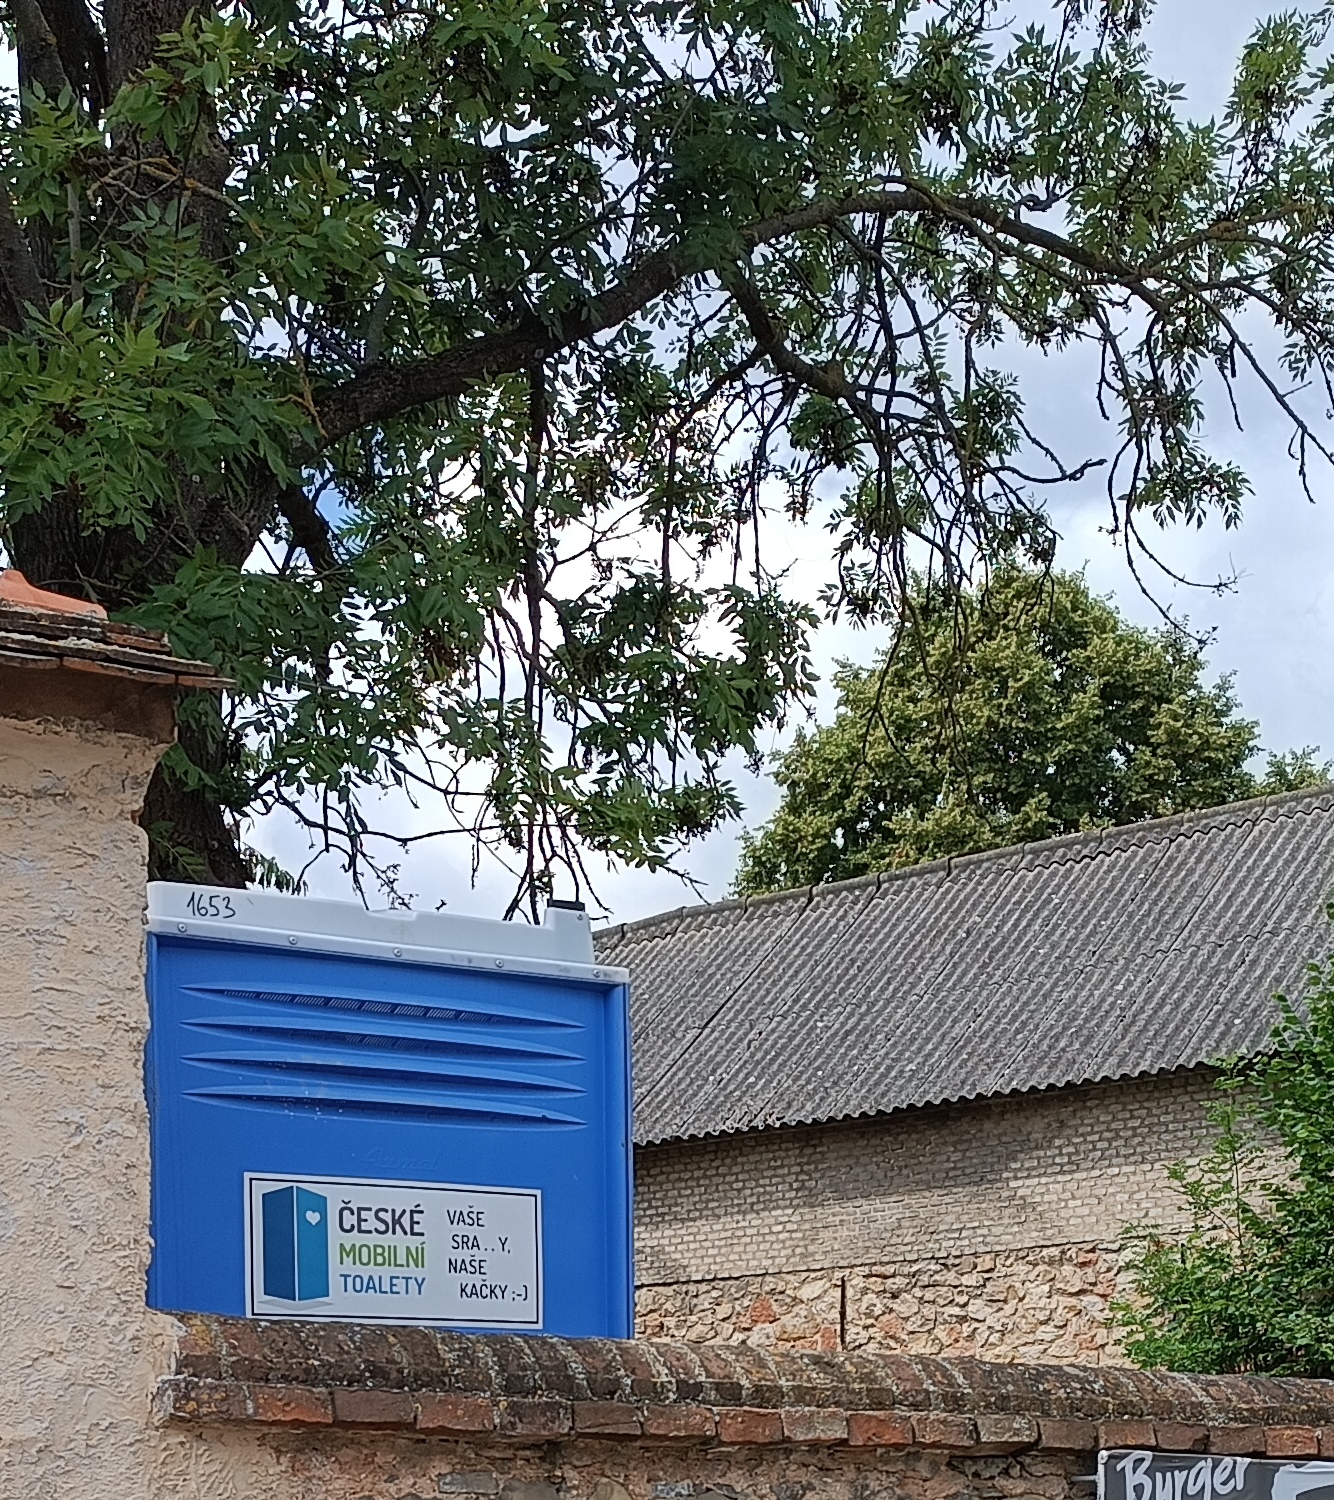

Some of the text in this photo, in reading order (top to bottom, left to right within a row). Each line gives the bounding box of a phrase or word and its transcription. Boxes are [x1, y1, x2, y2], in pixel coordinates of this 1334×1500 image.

[186, 891, 237, 919] 1653
[338, 1199, 425, 1237] ČESKÉ
[446, 1205, 485, 1227] VAŠE
[339, 1241, 426, 1269] MOBILNÍ
[448, 1254, 487, 1275] NAŠE
[339, 1273, 426, 1295] TOALETY
[460, 1278, 508, 1300] KAČKY
